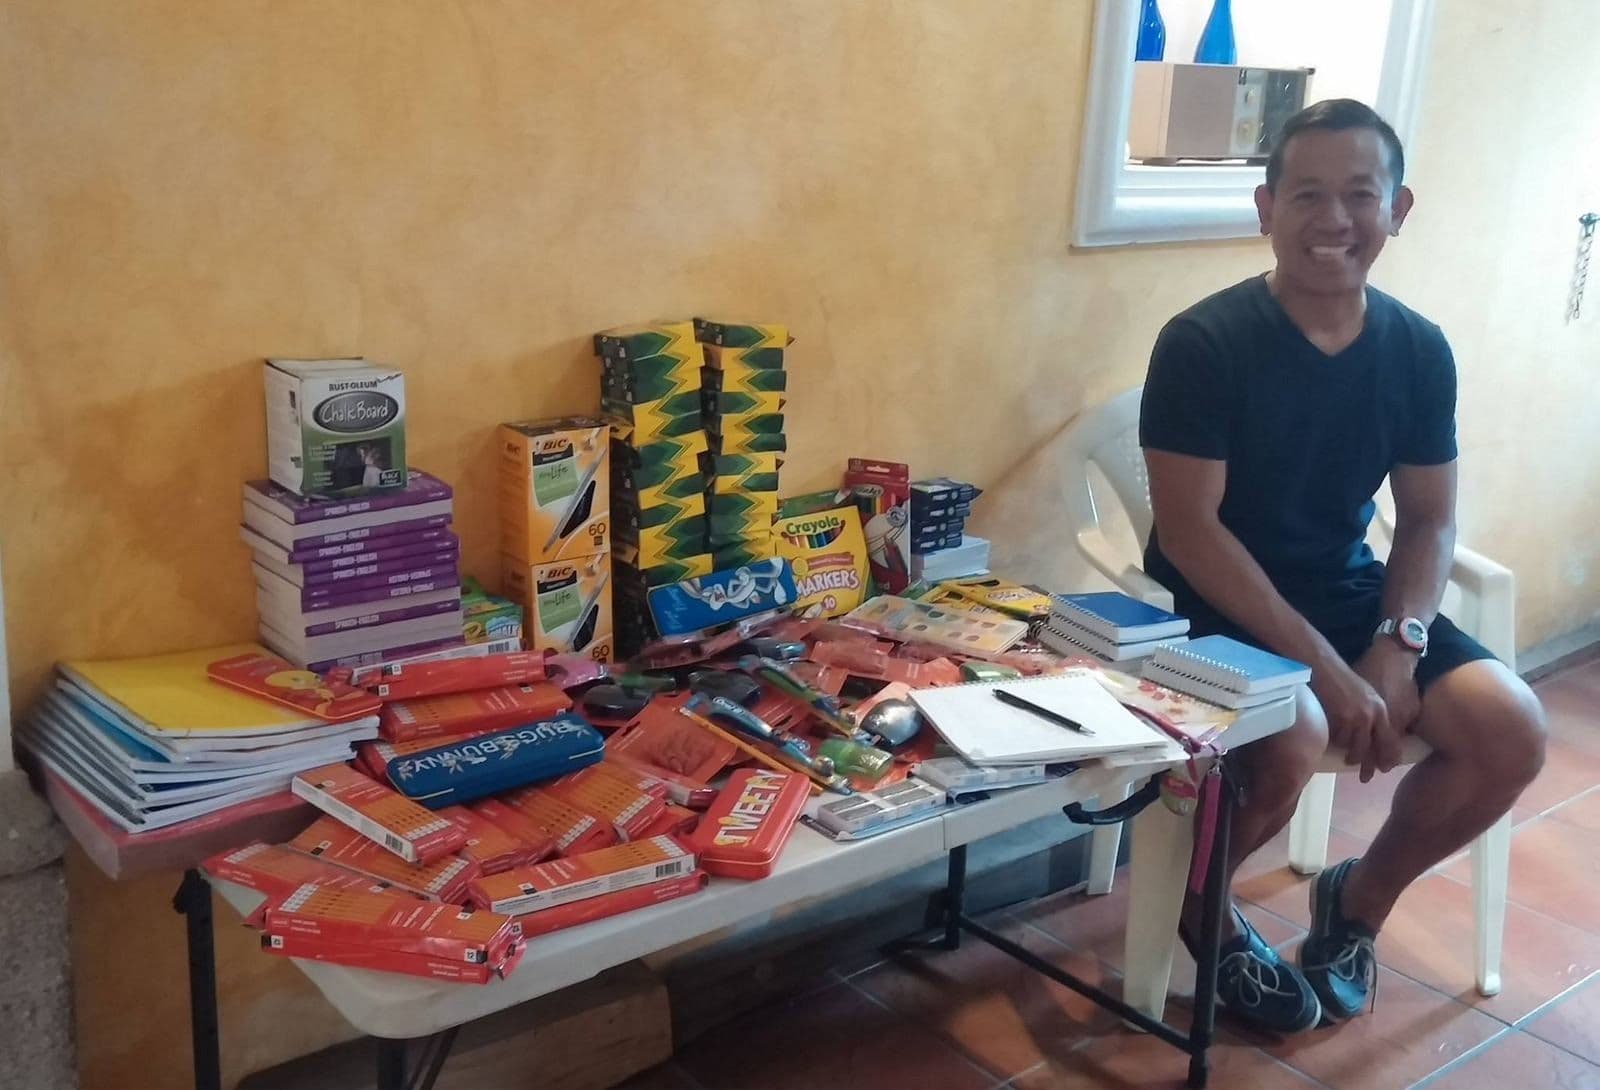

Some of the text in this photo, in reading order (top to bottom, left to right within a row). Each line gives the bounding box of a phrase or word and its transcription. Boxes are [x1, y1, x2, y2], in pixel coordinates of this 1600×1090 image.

[588, 522, 607, 536] 60
[785, 515, 840, 535] Crayola
[824, 597, 836, 609] 10
[592, 644, 610, 658] 60
